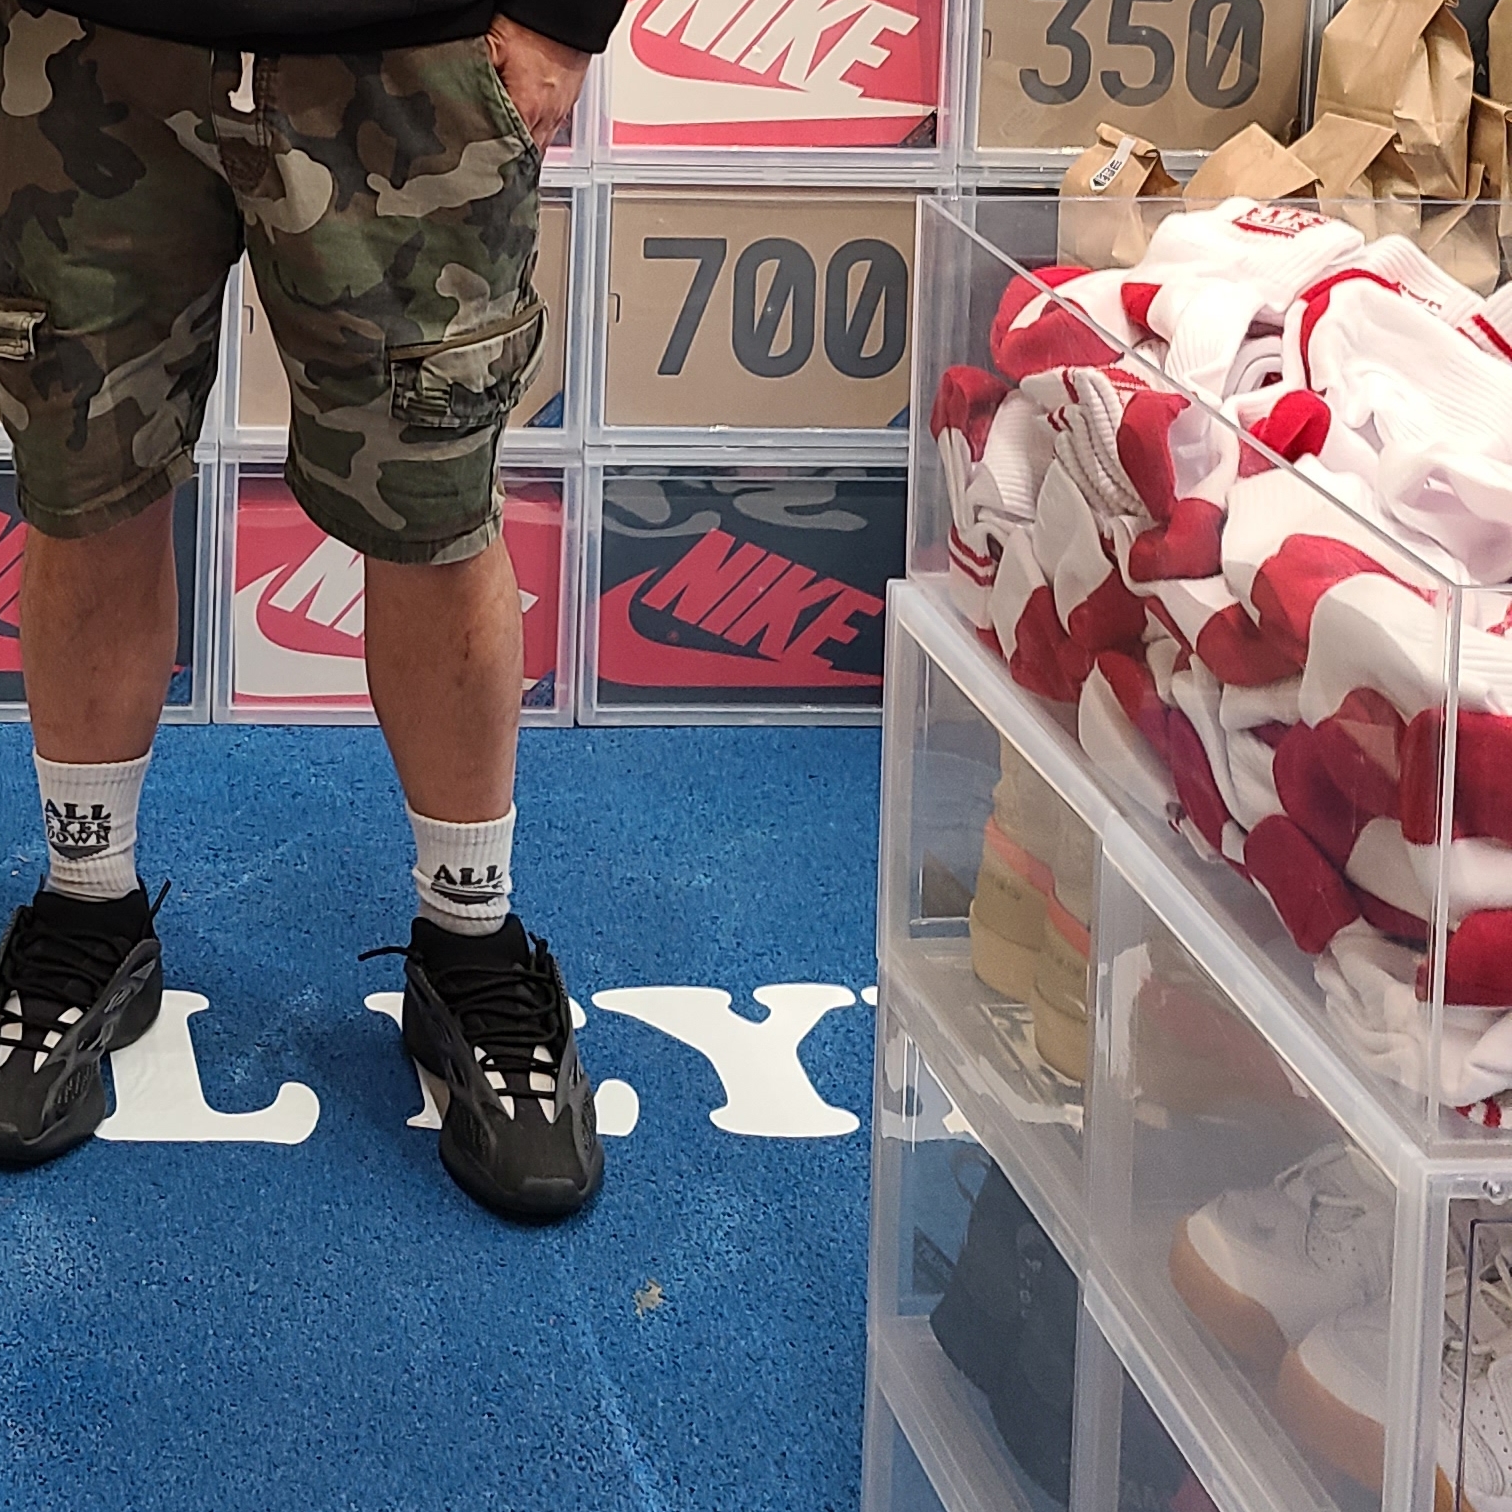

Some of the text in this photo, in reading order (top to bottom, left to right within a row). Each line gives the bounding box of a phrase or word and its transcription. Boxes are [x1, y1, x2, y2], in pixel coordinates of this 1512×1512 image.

[642, 238, 908, 379] 700
[641, 528, 885, 671] NIKE
[45, 798, 112, 820] ALL
[47, 829, 110, 845] DOWN
[433, 864, 504, 885] ALL
